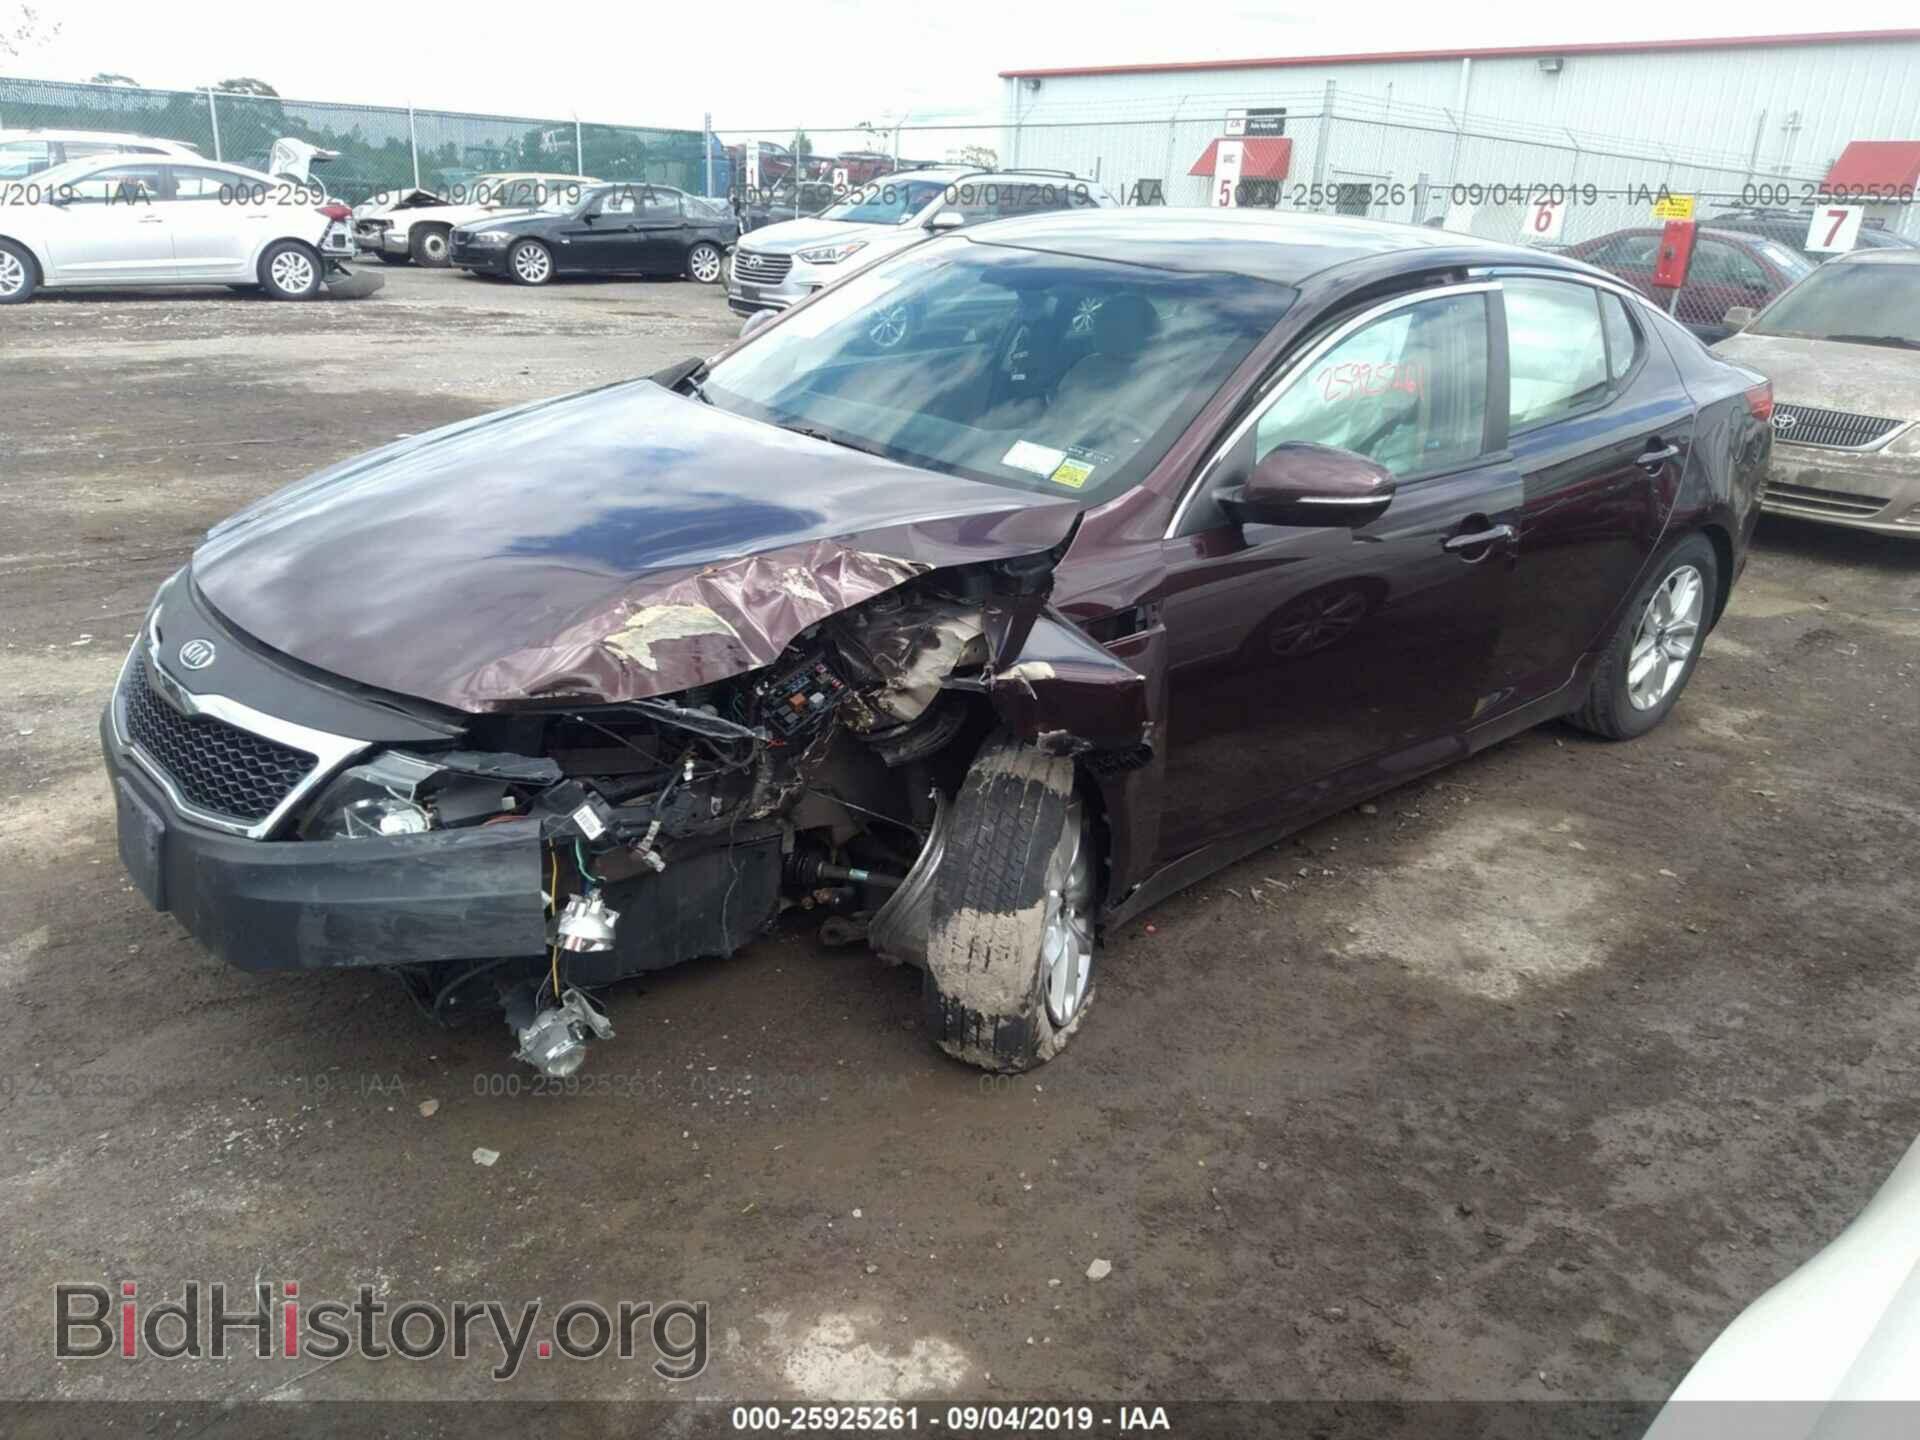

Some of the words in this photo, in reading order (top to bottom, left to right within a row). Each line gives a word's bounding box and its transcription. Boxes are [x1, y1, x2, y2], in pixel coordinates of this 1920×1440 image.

[1218, 179, 1232, 207] 5
[1534, 202, 1552, 232] 6
[1823, 209, 1849, 247] 7
